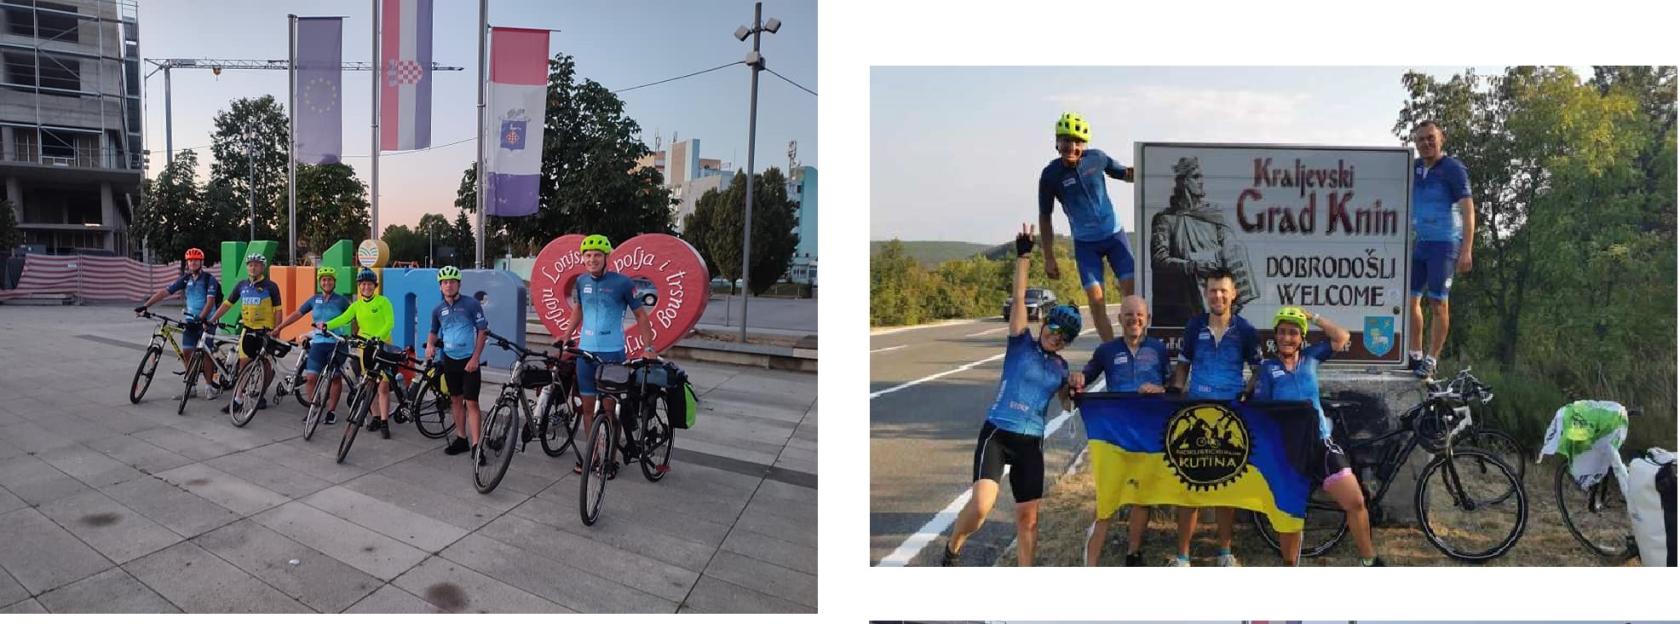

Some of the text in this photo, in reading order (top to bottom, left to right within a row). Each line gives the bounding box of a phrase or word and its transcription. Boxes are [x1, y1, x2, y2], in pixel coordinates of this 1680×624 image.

[1253, 157, 1355, 196] Kraljevski
[1236, 188, 1398, 236] Grad Knin
[541, 249, 585, 284] Lonjs
[613, 246, 656, 275] polja
[658, 258, 672, 273] i
[1266, 248, 1396, 279] DOBRODOŠLI
[656, 270, 688, 330] trsnog
[1277, 284, 1385, 307] WELCOME
[1179, 457, 1237, 469] KUTINA
